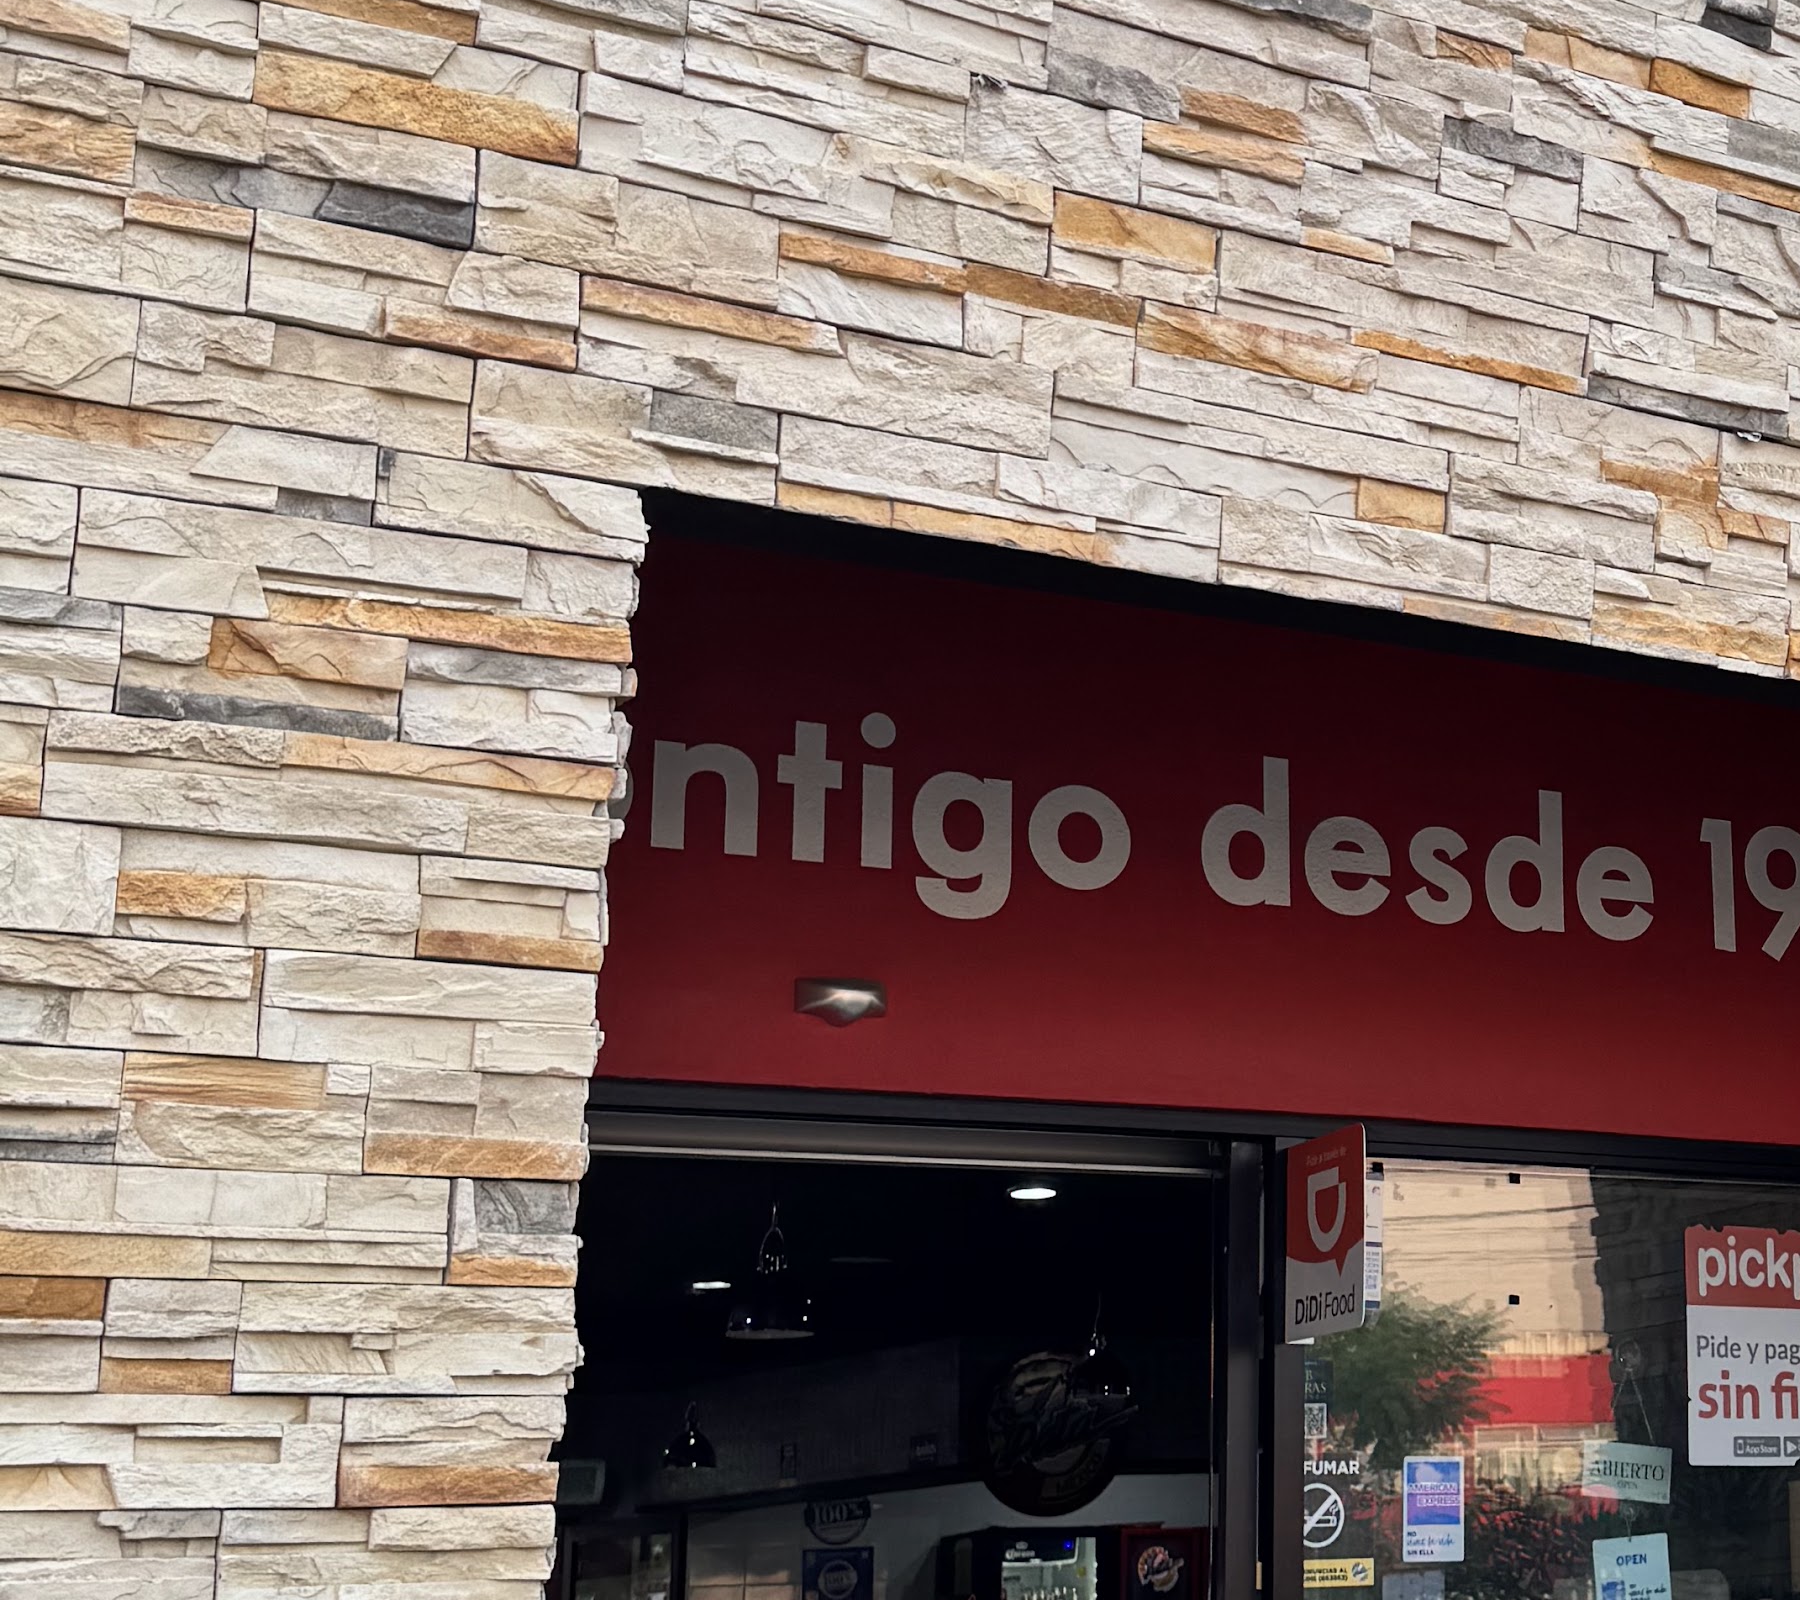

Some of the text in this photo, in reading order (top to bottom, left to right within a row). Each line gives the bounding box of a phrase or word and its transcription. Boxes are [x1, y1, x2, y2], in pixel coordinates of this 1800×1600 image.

[1200, 756, 1655, 942] desde
[1295, 1284, 1356, 1326] DiDi Food
[1696, 1335, 1742, 1359] Pide
[1746, 1342, 1759, 1365] y
[1698, 1370, 1760, 1420] sin
[1303, 1460, 1360, 1476] FUMAR
[1407, 1483, 1457, 1494] AMERICAN
[1417, 1495, 1461, 1507] EXPRESS
[1616, 1554, 1647, 1567] OPEN
